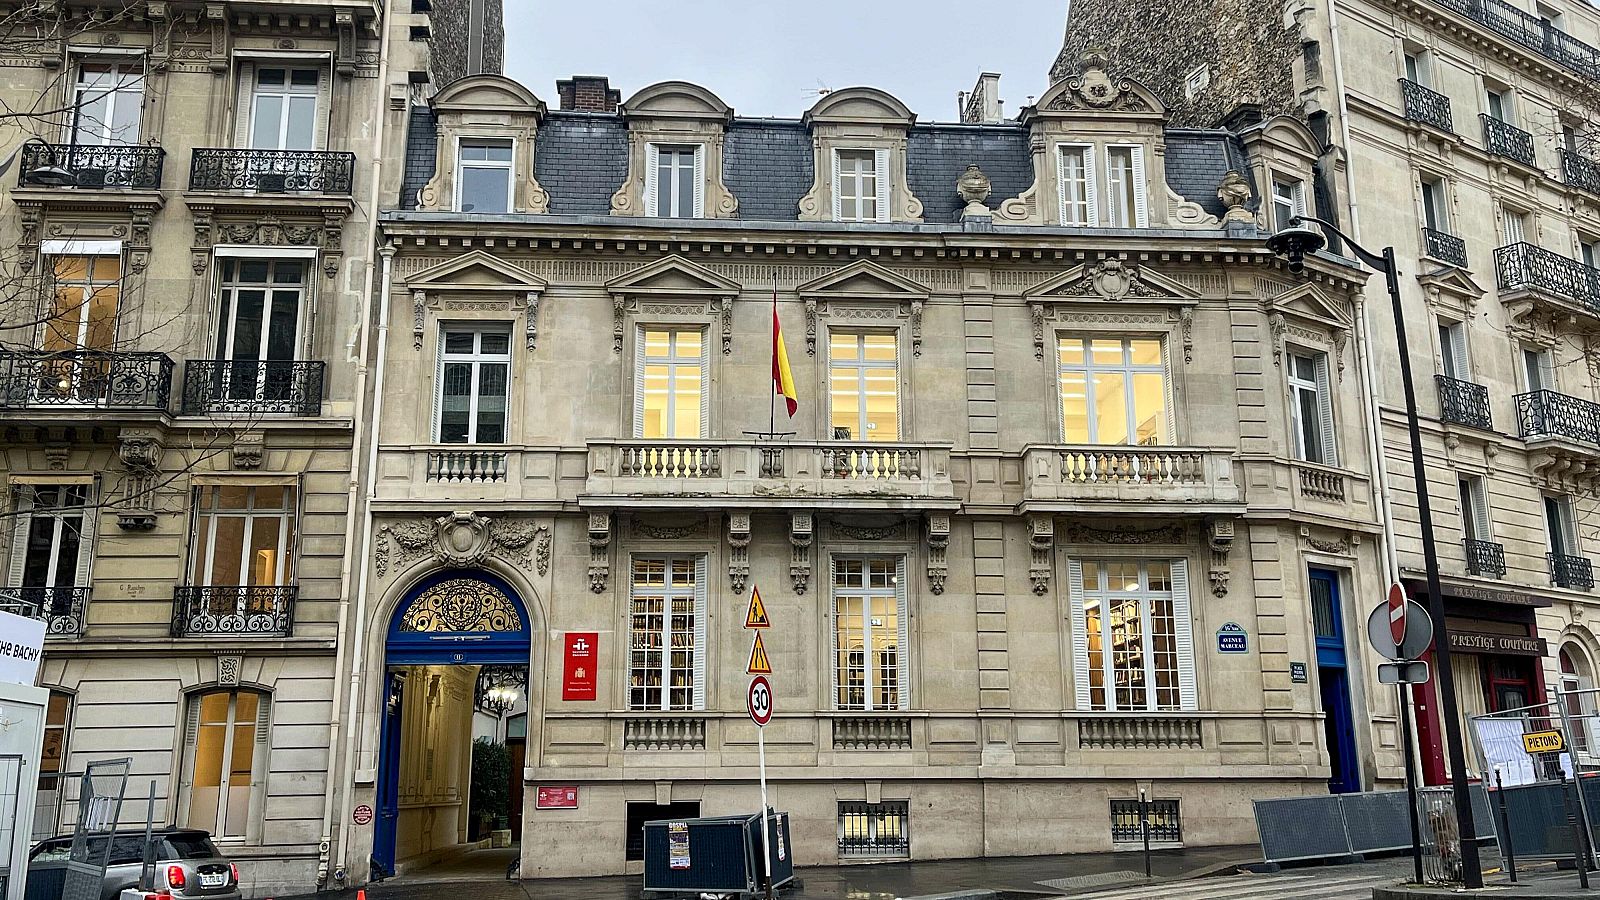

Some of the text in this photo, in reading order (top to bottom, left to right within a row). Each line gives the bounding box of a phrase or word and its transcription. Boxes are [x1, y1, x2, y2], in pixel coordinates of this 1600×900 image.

[1453, 588, 1532, 604] PRESTIGE COUTURE
[1451, 634, 1539, 652] PRESTIGE COUTURE
[13, 644, 40, 662] BACHY
[753, 688, 768, 711] 30
[1527, 735, 1559, 748] PIETONS
